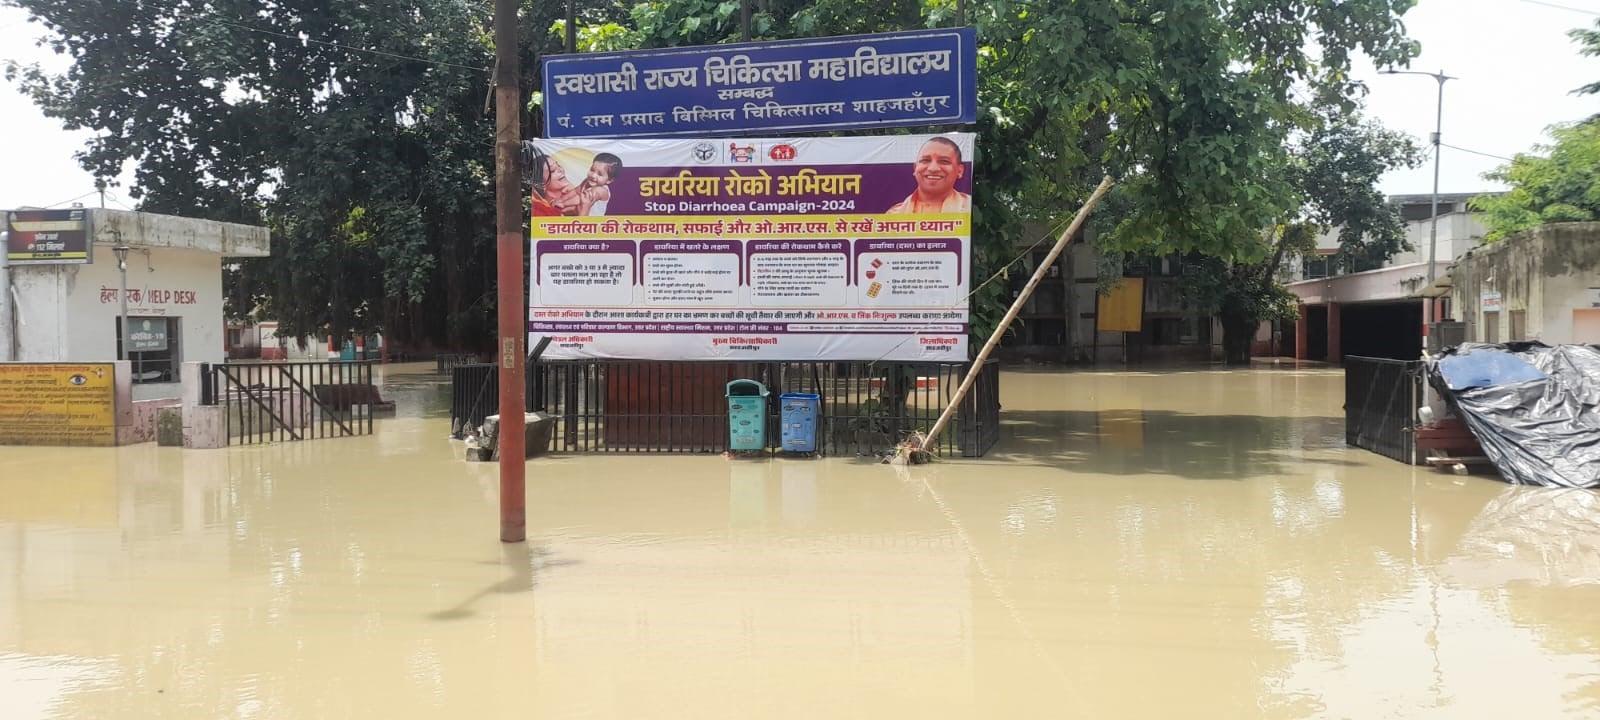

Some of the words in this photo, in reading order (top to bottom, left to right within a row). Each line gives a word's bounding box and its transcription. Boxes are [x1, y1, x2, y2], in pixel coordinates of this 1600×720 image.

[553, 62, 638, 95] स्वशासी
[644, 67, 698, 90] राज्य
[704, 55, 802, 88] चिकित्सा
[808, 46, 951, 81] महाविद्यालय
[717, 86, 775, 101] सम्बद्ध
[557, 113, 575, 129] पं.
[582, 114, 614, 128] राम
[620, 112, 666, 127] प्रसाद
[742, 101, 845, 120] चिकित्सालय
[852, 91, 950, 114] शाहजहाँपुर
[638, 170, 720, 197] डायरिया
[724, 169, 771, 196] रोको
[777, 168, 862, 195] अभियान
[644, 201, 676, 213] Stop
[679, 200, 745, 212] Diarrhoea
[749, 199, 855, 213] Campaign-2024
[540, 220, 597, 234] "डायरिया
[601, 220, 619, 234] की
[623, 220, 679, 235] रोकथाम,
[683, 219, 724, 236] सफाई
[727, 219, 751, 234] और
[755, 219, 832, 233] ओ.आर.एस.
[835, 217, 848, 233] से
[850, 217, 873, 233] रखें
[877, 220, 915, 232] अपना
[919, 220, 962, 232] ध्यान"
[147, 289, 171, 304] HELP
[174, 290, 197, 304] DESK
